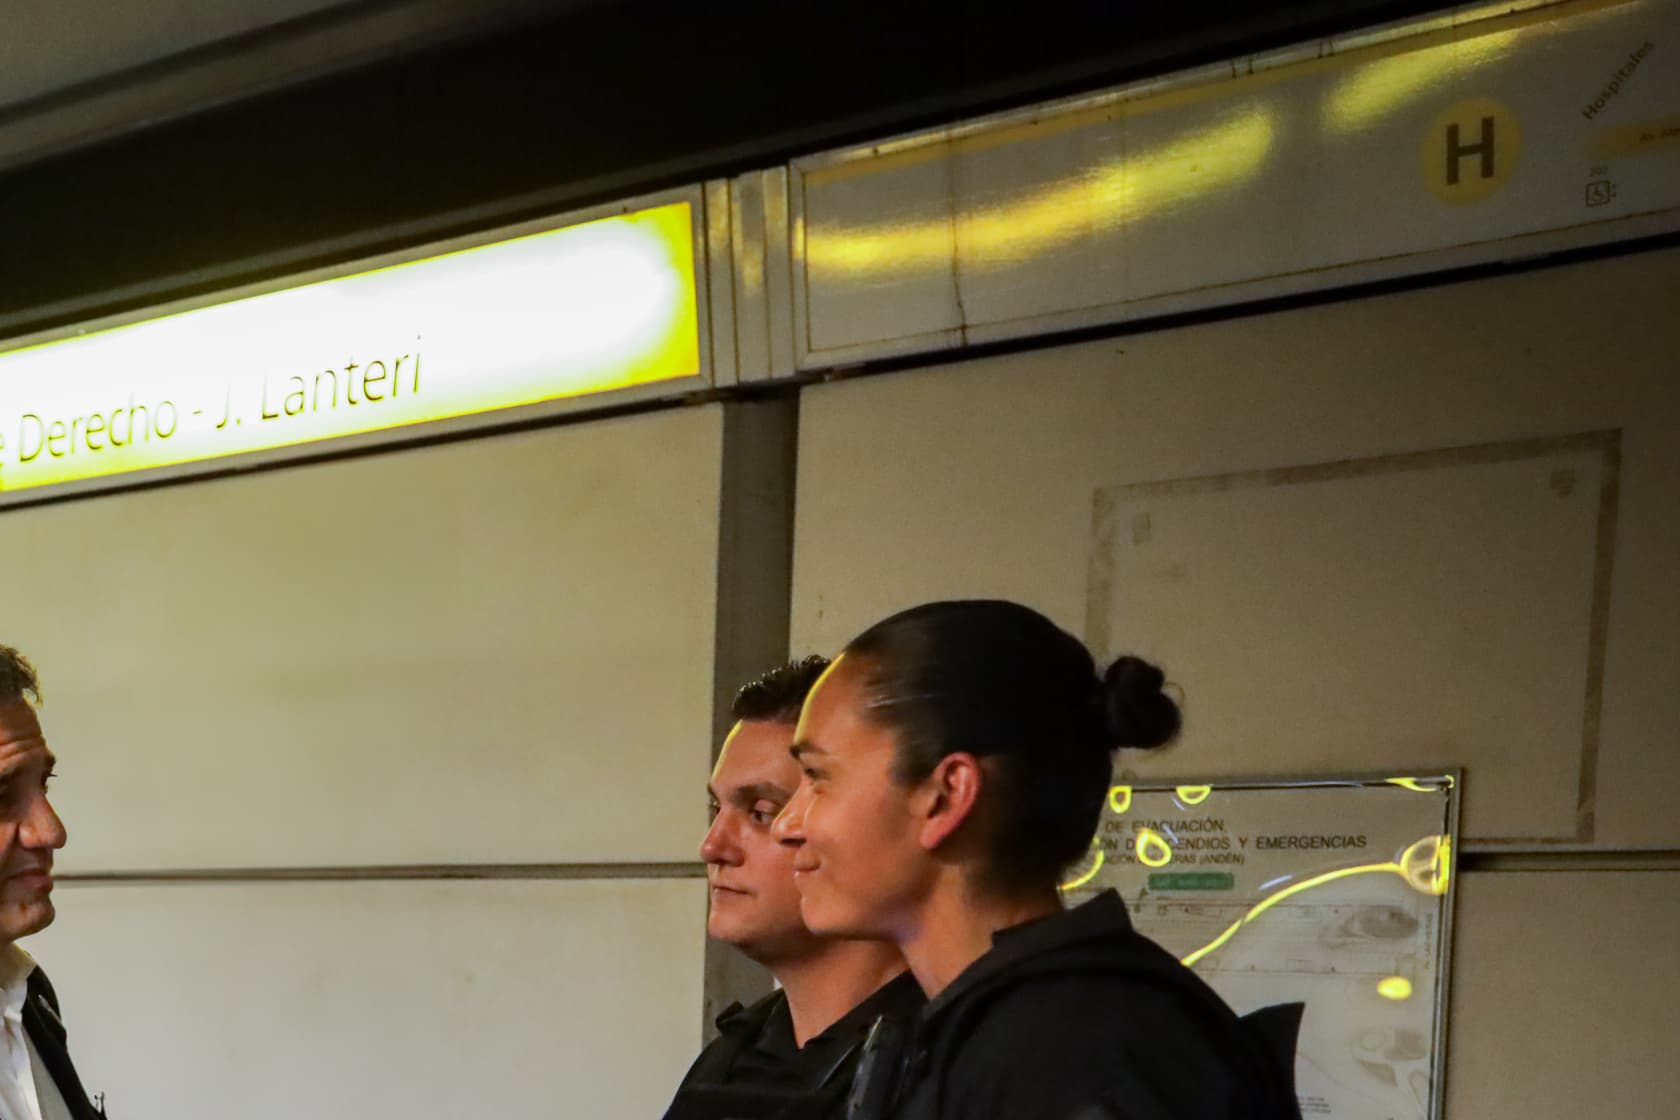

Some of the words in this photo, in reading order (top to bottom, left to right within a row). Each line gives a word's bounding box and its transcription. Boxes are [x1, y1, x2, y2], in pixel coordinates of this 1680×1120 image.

[1581, 40, 1655, 121] Hospitales
[1445, 115, 1496, 186] H
[18, 390, 178, 464] Derecho
[215, 380, 242, 430] J.
[261, 333, 422, 420] Lanteri
[1105, 820, 1123, 833] DE
[1238, 836, 1248, 850] Y
[1255, 834, 1367, 850] EMERGENCIAS
